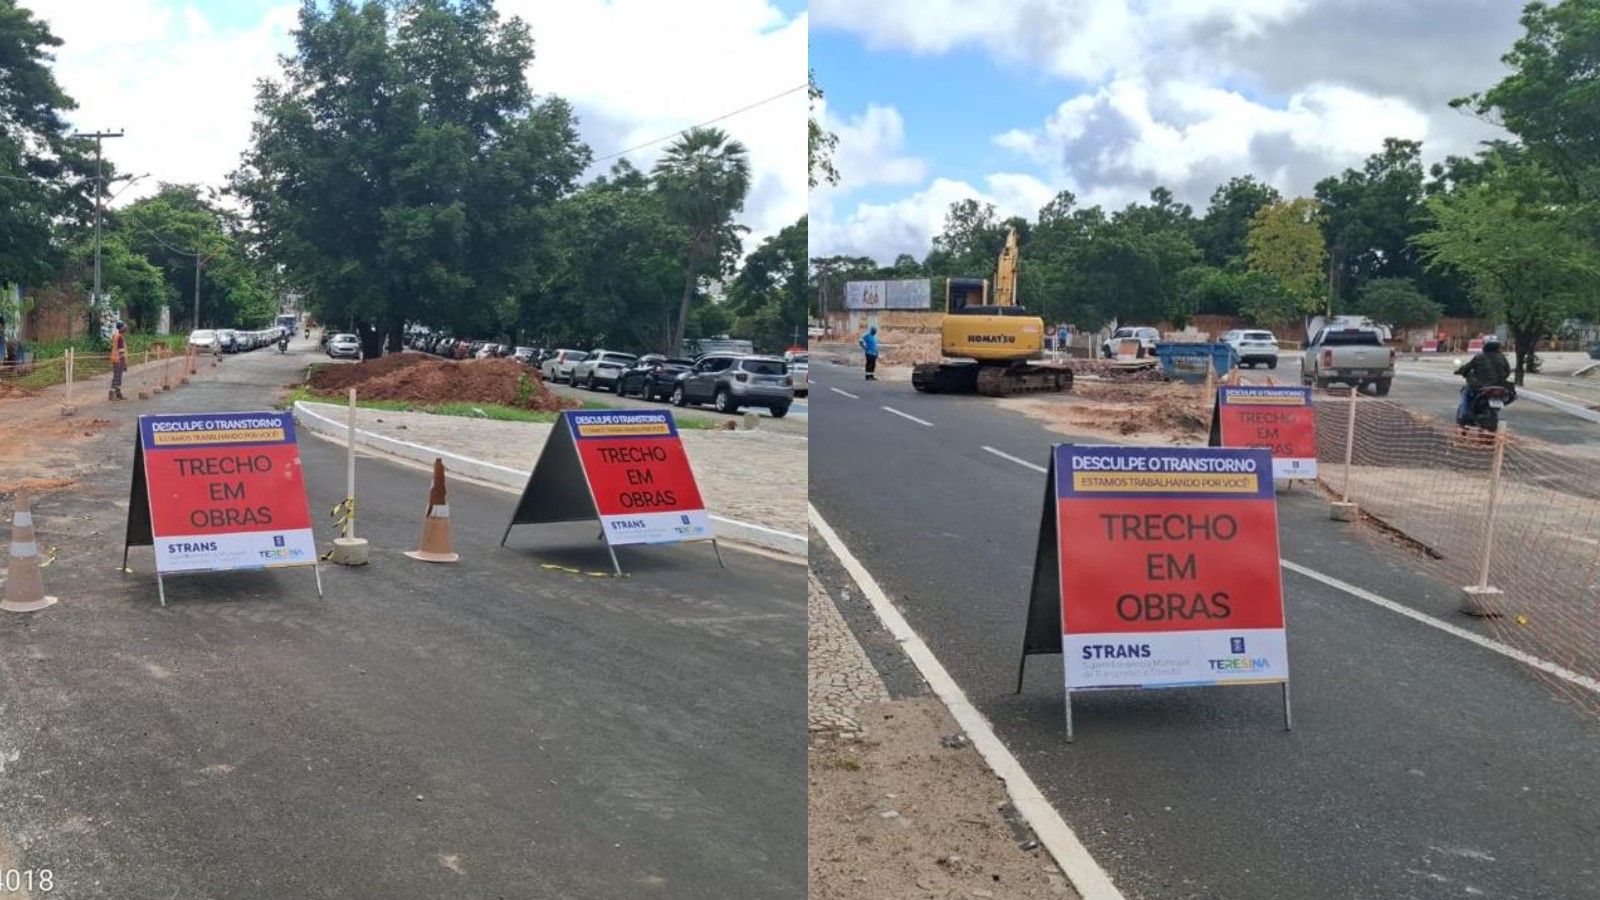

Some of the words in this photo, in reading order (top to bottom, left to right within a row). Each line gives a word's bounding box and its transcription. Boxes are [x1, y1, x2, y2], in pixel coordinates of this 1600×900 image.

[968, 334, 1015, 343] KOMATSU
[152, 420, 205, 432] DESCULPE
[205, 420, 214, 430] O
[216, 418, 282, 430] TRANSTORNO
[575, 415, 611, 424] DESCULPE
[619, 415, 666, 423] TRANSTORNO
[1257, 428, 1278, 439] EM
[596, 446, 667, 463] TRECHO
[174, 455, 272, 477] TRECHO
[1072, 455, 1146, 471] DESCULPE
[1148, 457, 1160, 471] O
[1160, 457, 1257, 472] TRANSTORNO
[626, 469, 653, 485] EM
[1081, 477, 1127, 487] ESTAMOS
[1129, 477, 1200, 488] TRABALHANDO
[1202, 479, 1223, 488] POR
[209, 482, 245, 501] EM
[619, 490, 677, 508] OBRAS
[190, 506, 272, 528] OBRAS
[611, 520, 646, 530] STRANS
[1099, 513, 1237, 541] TRECHO
[168, 542, 218, 553] STRANS
[1146, 553, 1197, 580] EM
[1116, 592, 1232, 621] OBRAS
[1082, 644, 1151, 660] STRANS
[1207, 657, 1270, 671] TERESINA
